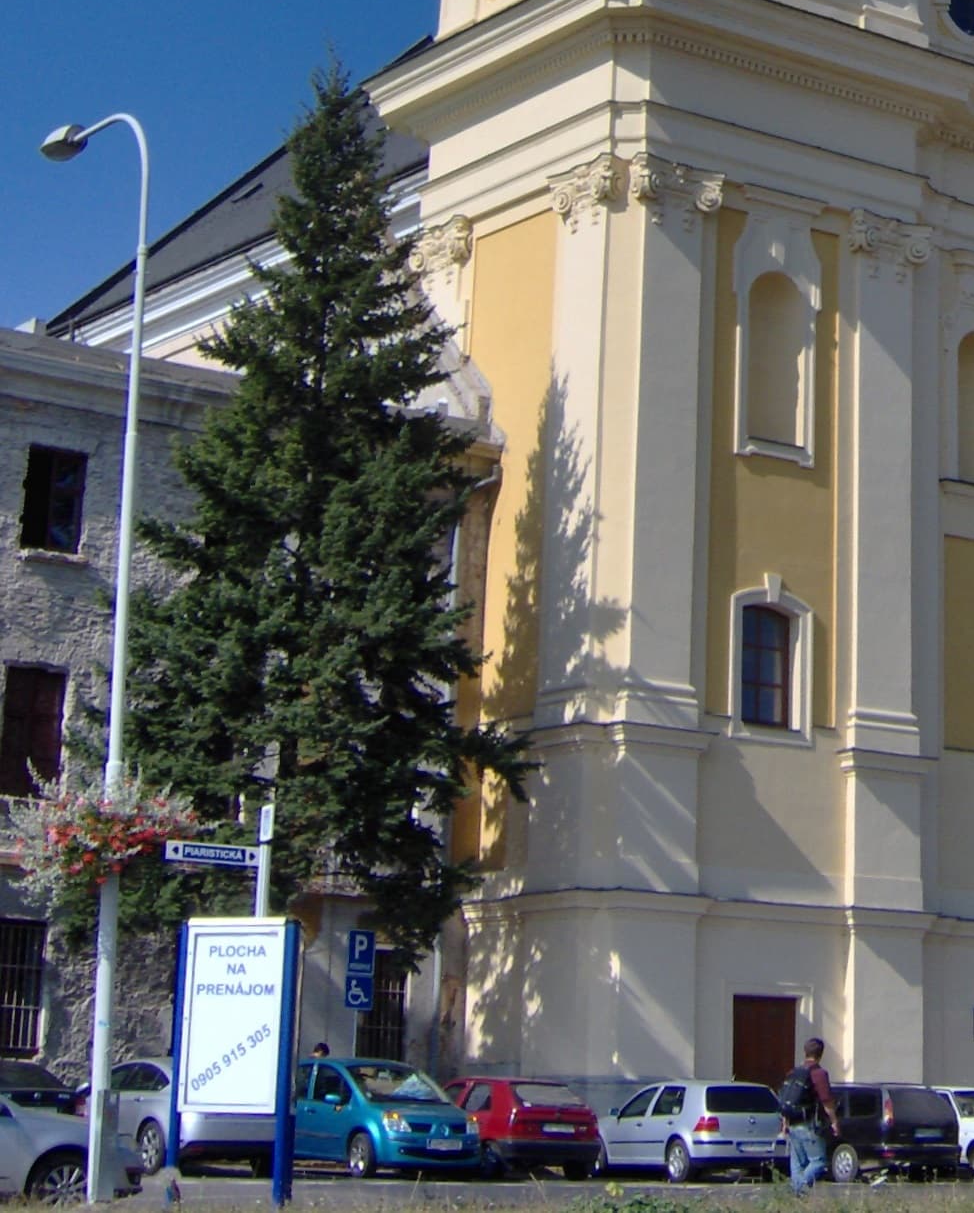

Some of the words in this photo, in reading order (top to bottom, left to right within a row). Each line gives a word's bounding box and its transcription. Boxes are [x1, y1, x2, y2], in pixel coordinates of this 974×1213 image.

[184, 846, 243, 861] PIARISTICKÁ
[208, 945, 267, 958] PLOCHA
[354, 934, 368, 960] P
[226, 963, 247, 976] NA
[196, 981, 276, 997] PRENÁJOM
[190, 1061, 222, 1092] 0905
[221, 1042, 248, 1068] 915
[246, 1023, 272, 1049] 305
